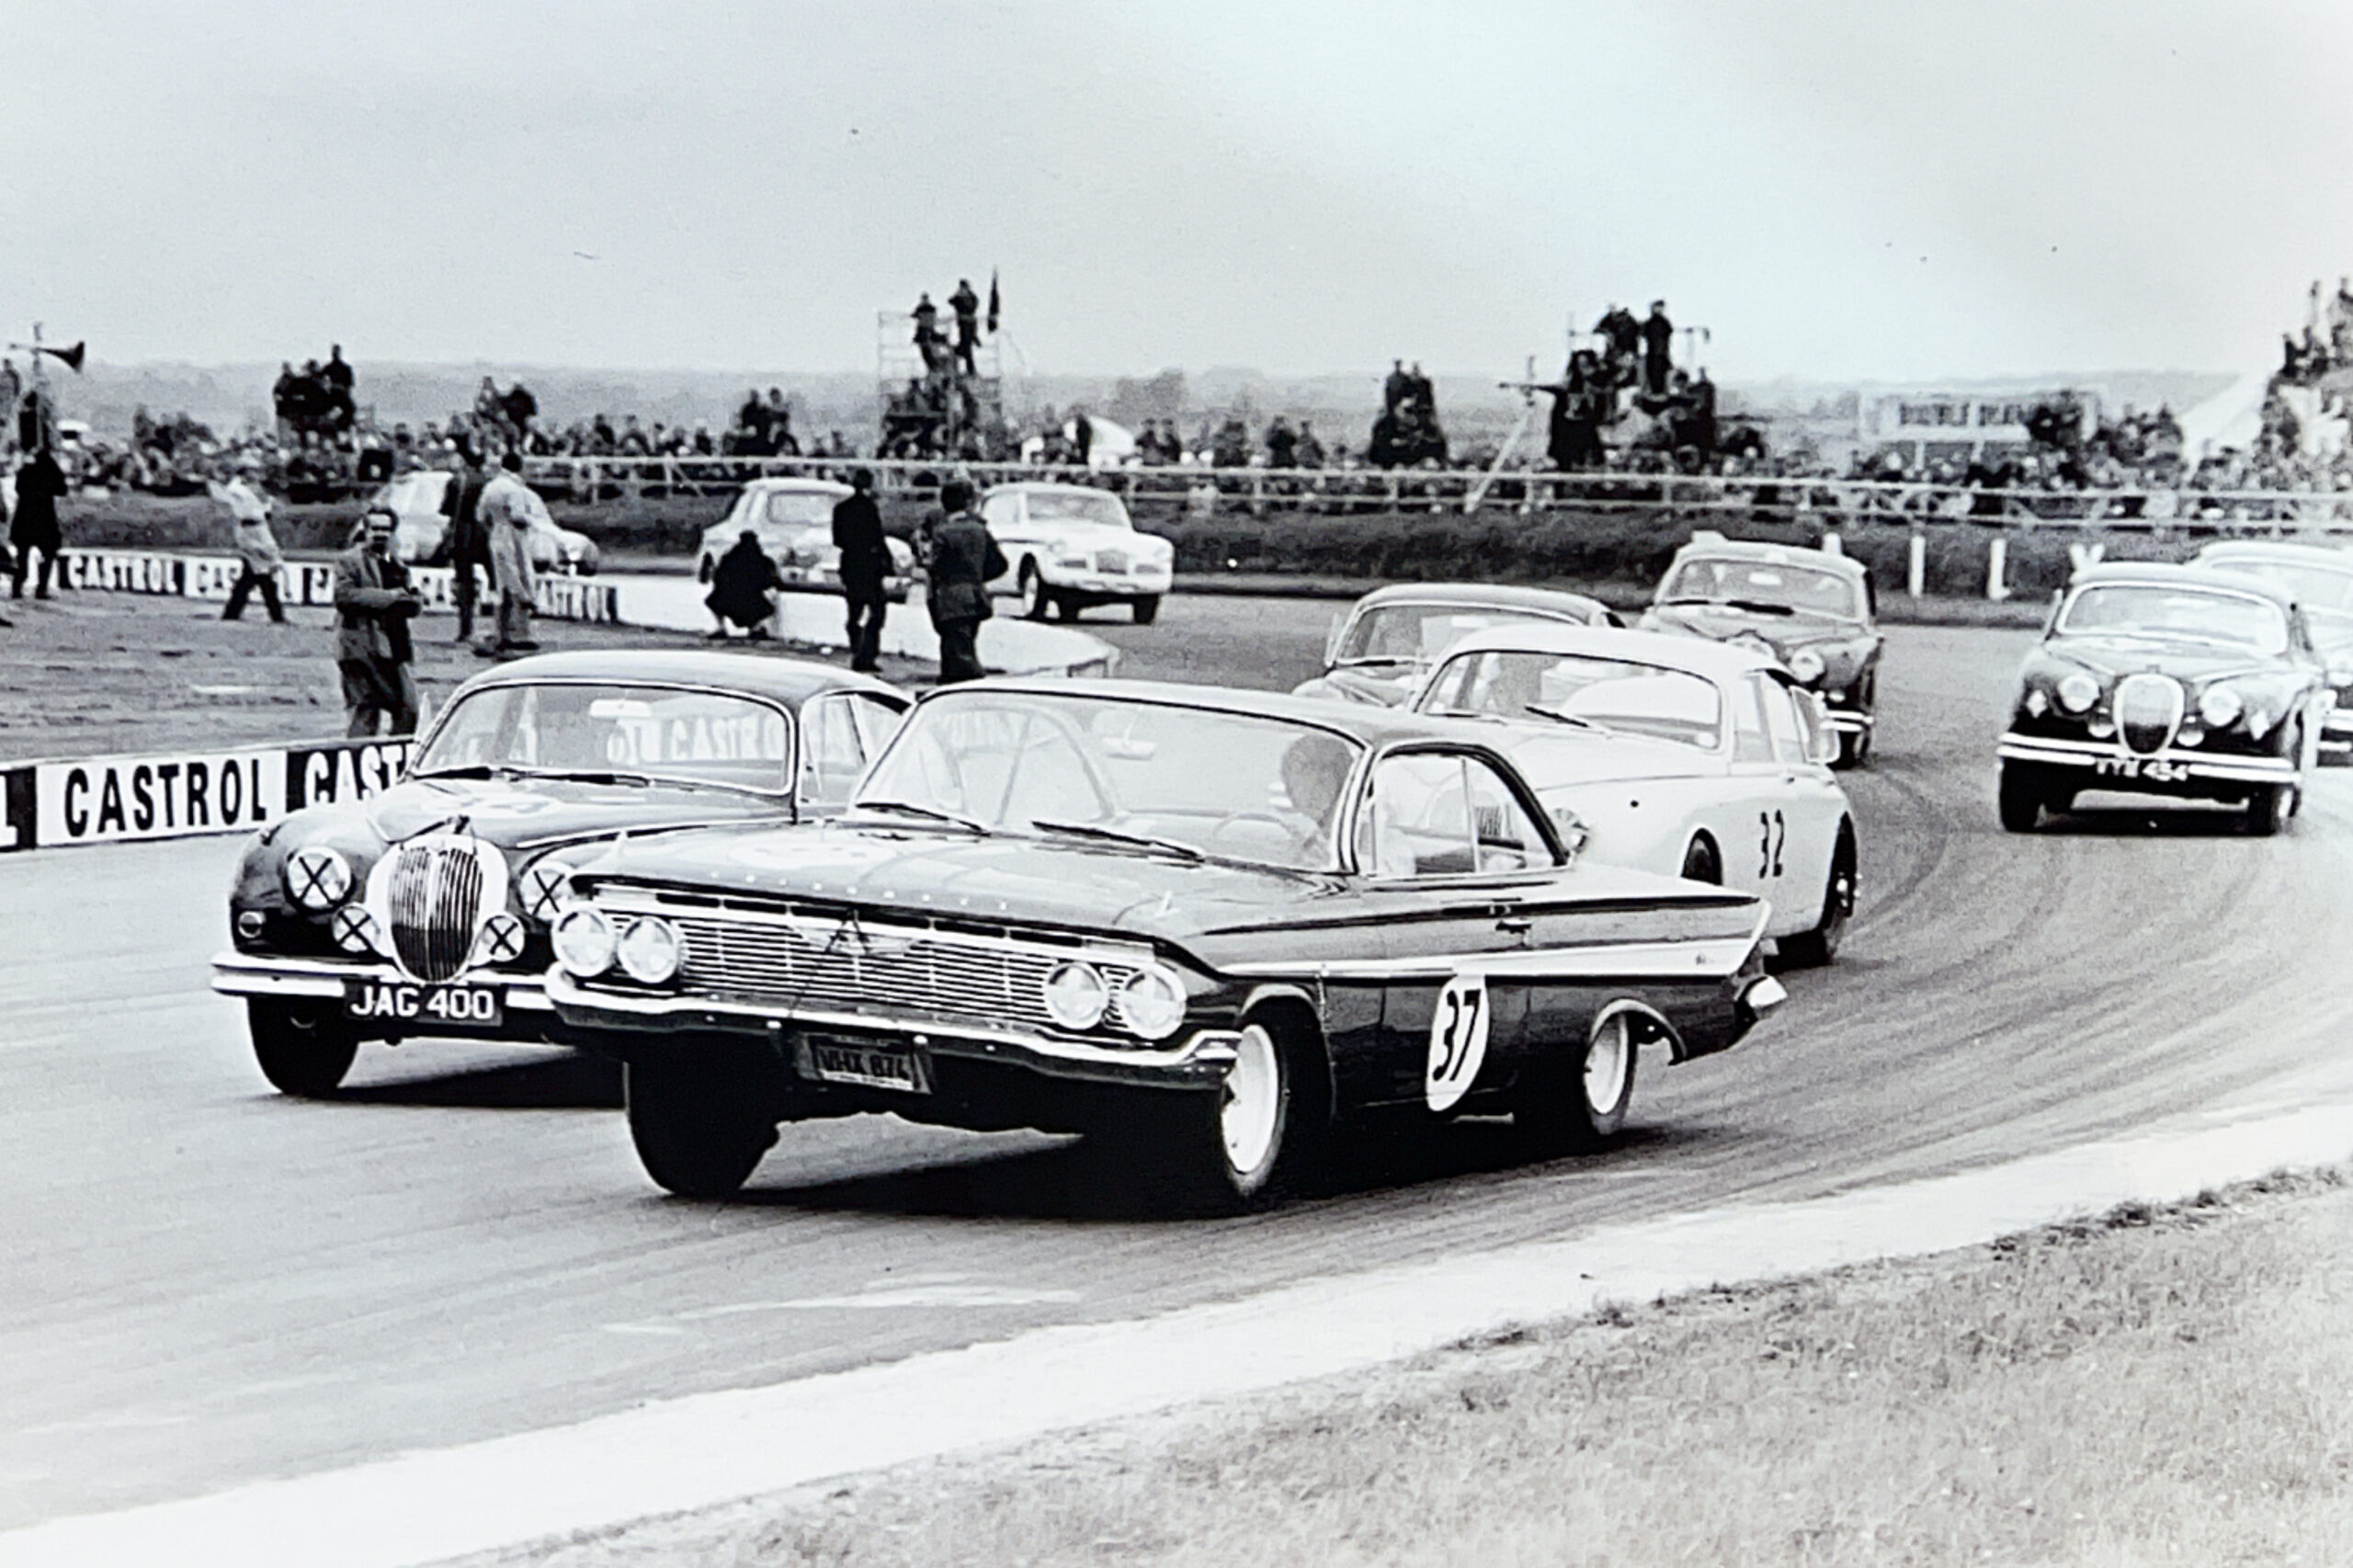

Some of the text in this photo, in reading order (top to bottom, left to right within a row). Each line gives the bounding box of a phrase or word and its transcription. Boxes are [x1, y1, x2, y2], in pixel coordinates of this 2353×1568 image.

[68, 554, 178, 593] CASTROL
[63, 758, 267, 838] CASTROL
[303, 743, 410, 804] CAST
[1758, 809, 1785, 880] 32
[350, 984, 494, 1020] JAG 400
[1432, 988, 1482, 1083] 37
